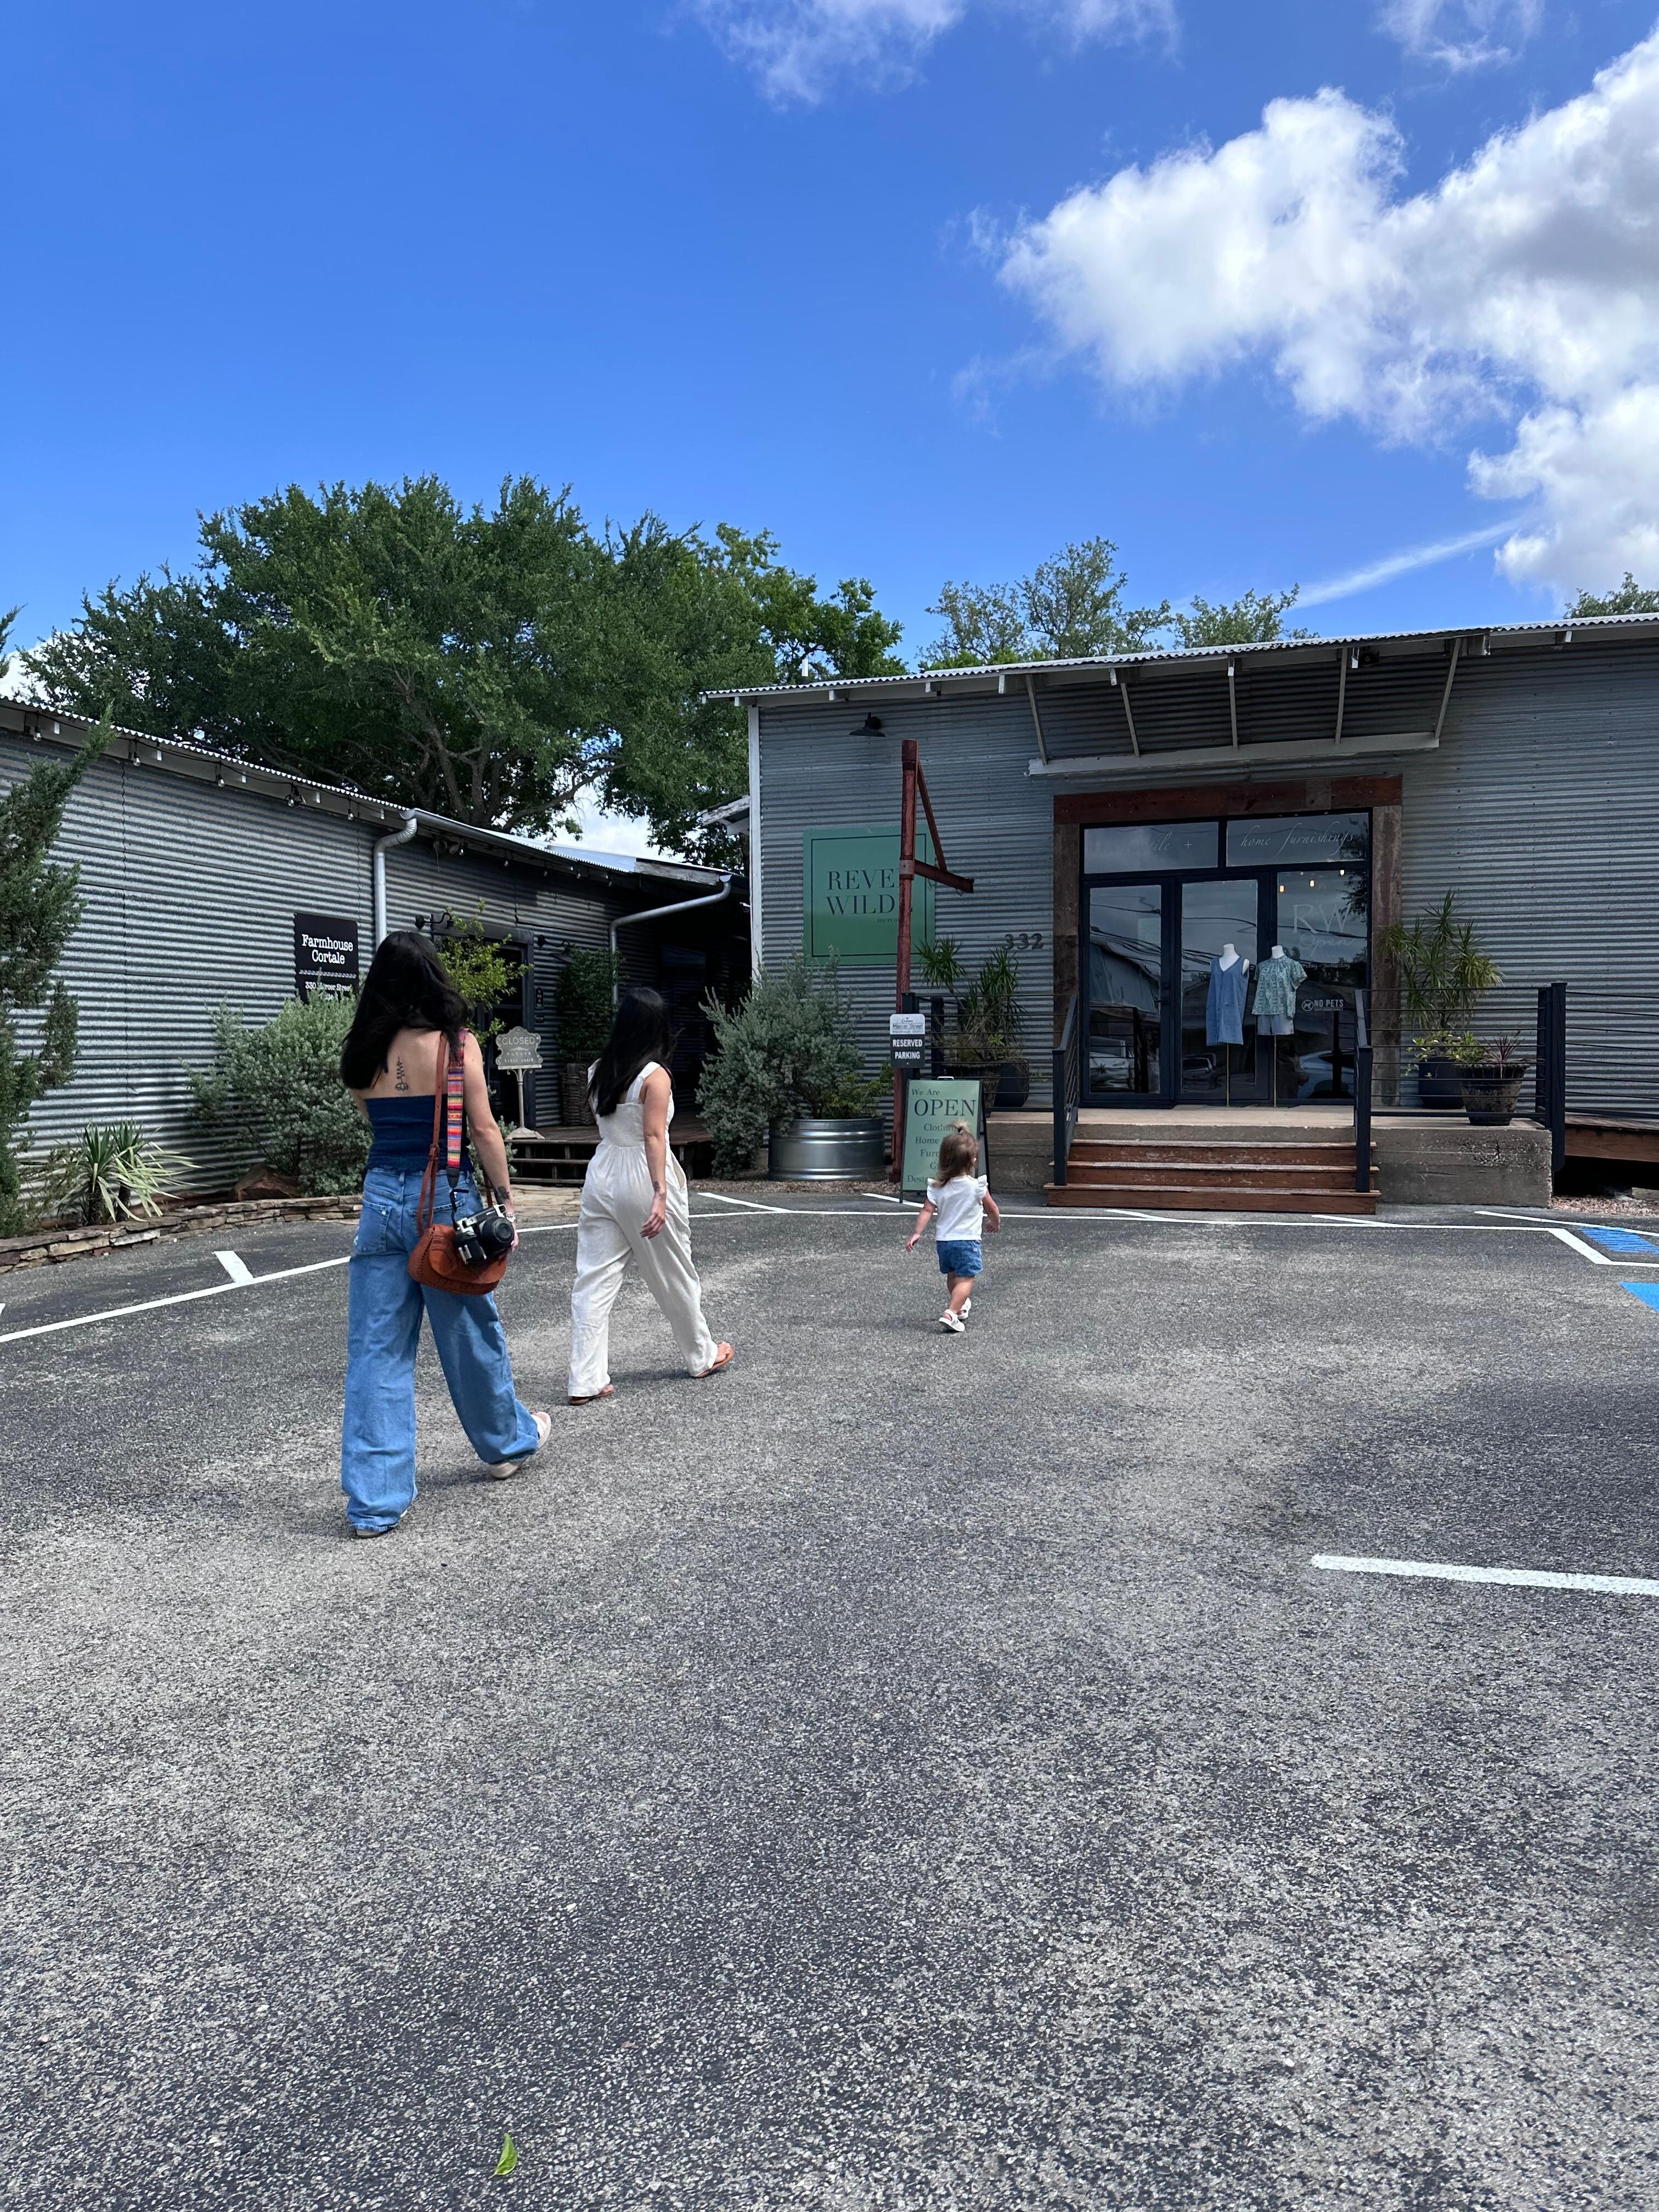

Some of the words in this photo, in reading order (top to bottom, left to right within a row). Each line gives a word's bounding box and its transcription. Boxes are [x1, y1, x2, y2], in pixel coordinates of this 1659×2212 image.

[1240, 825, 1272, 847] home
[827, 868, 900, 890] REVE
[825, 894, 912, 916] WILD
[1293, 903, 1352, 934] RW
[302, 934, 353, 951] Farmhouse
[1002, 933, 1043, 950] 332
[312, 950, 345, 964] Cortale
[1314, 999, 1323, 1007] NO
[1325, 999, 1344, 1007] PETS
[895, 1051, 921, 1059] PARKING
[914, 1099, 976, 1116] OPEN
